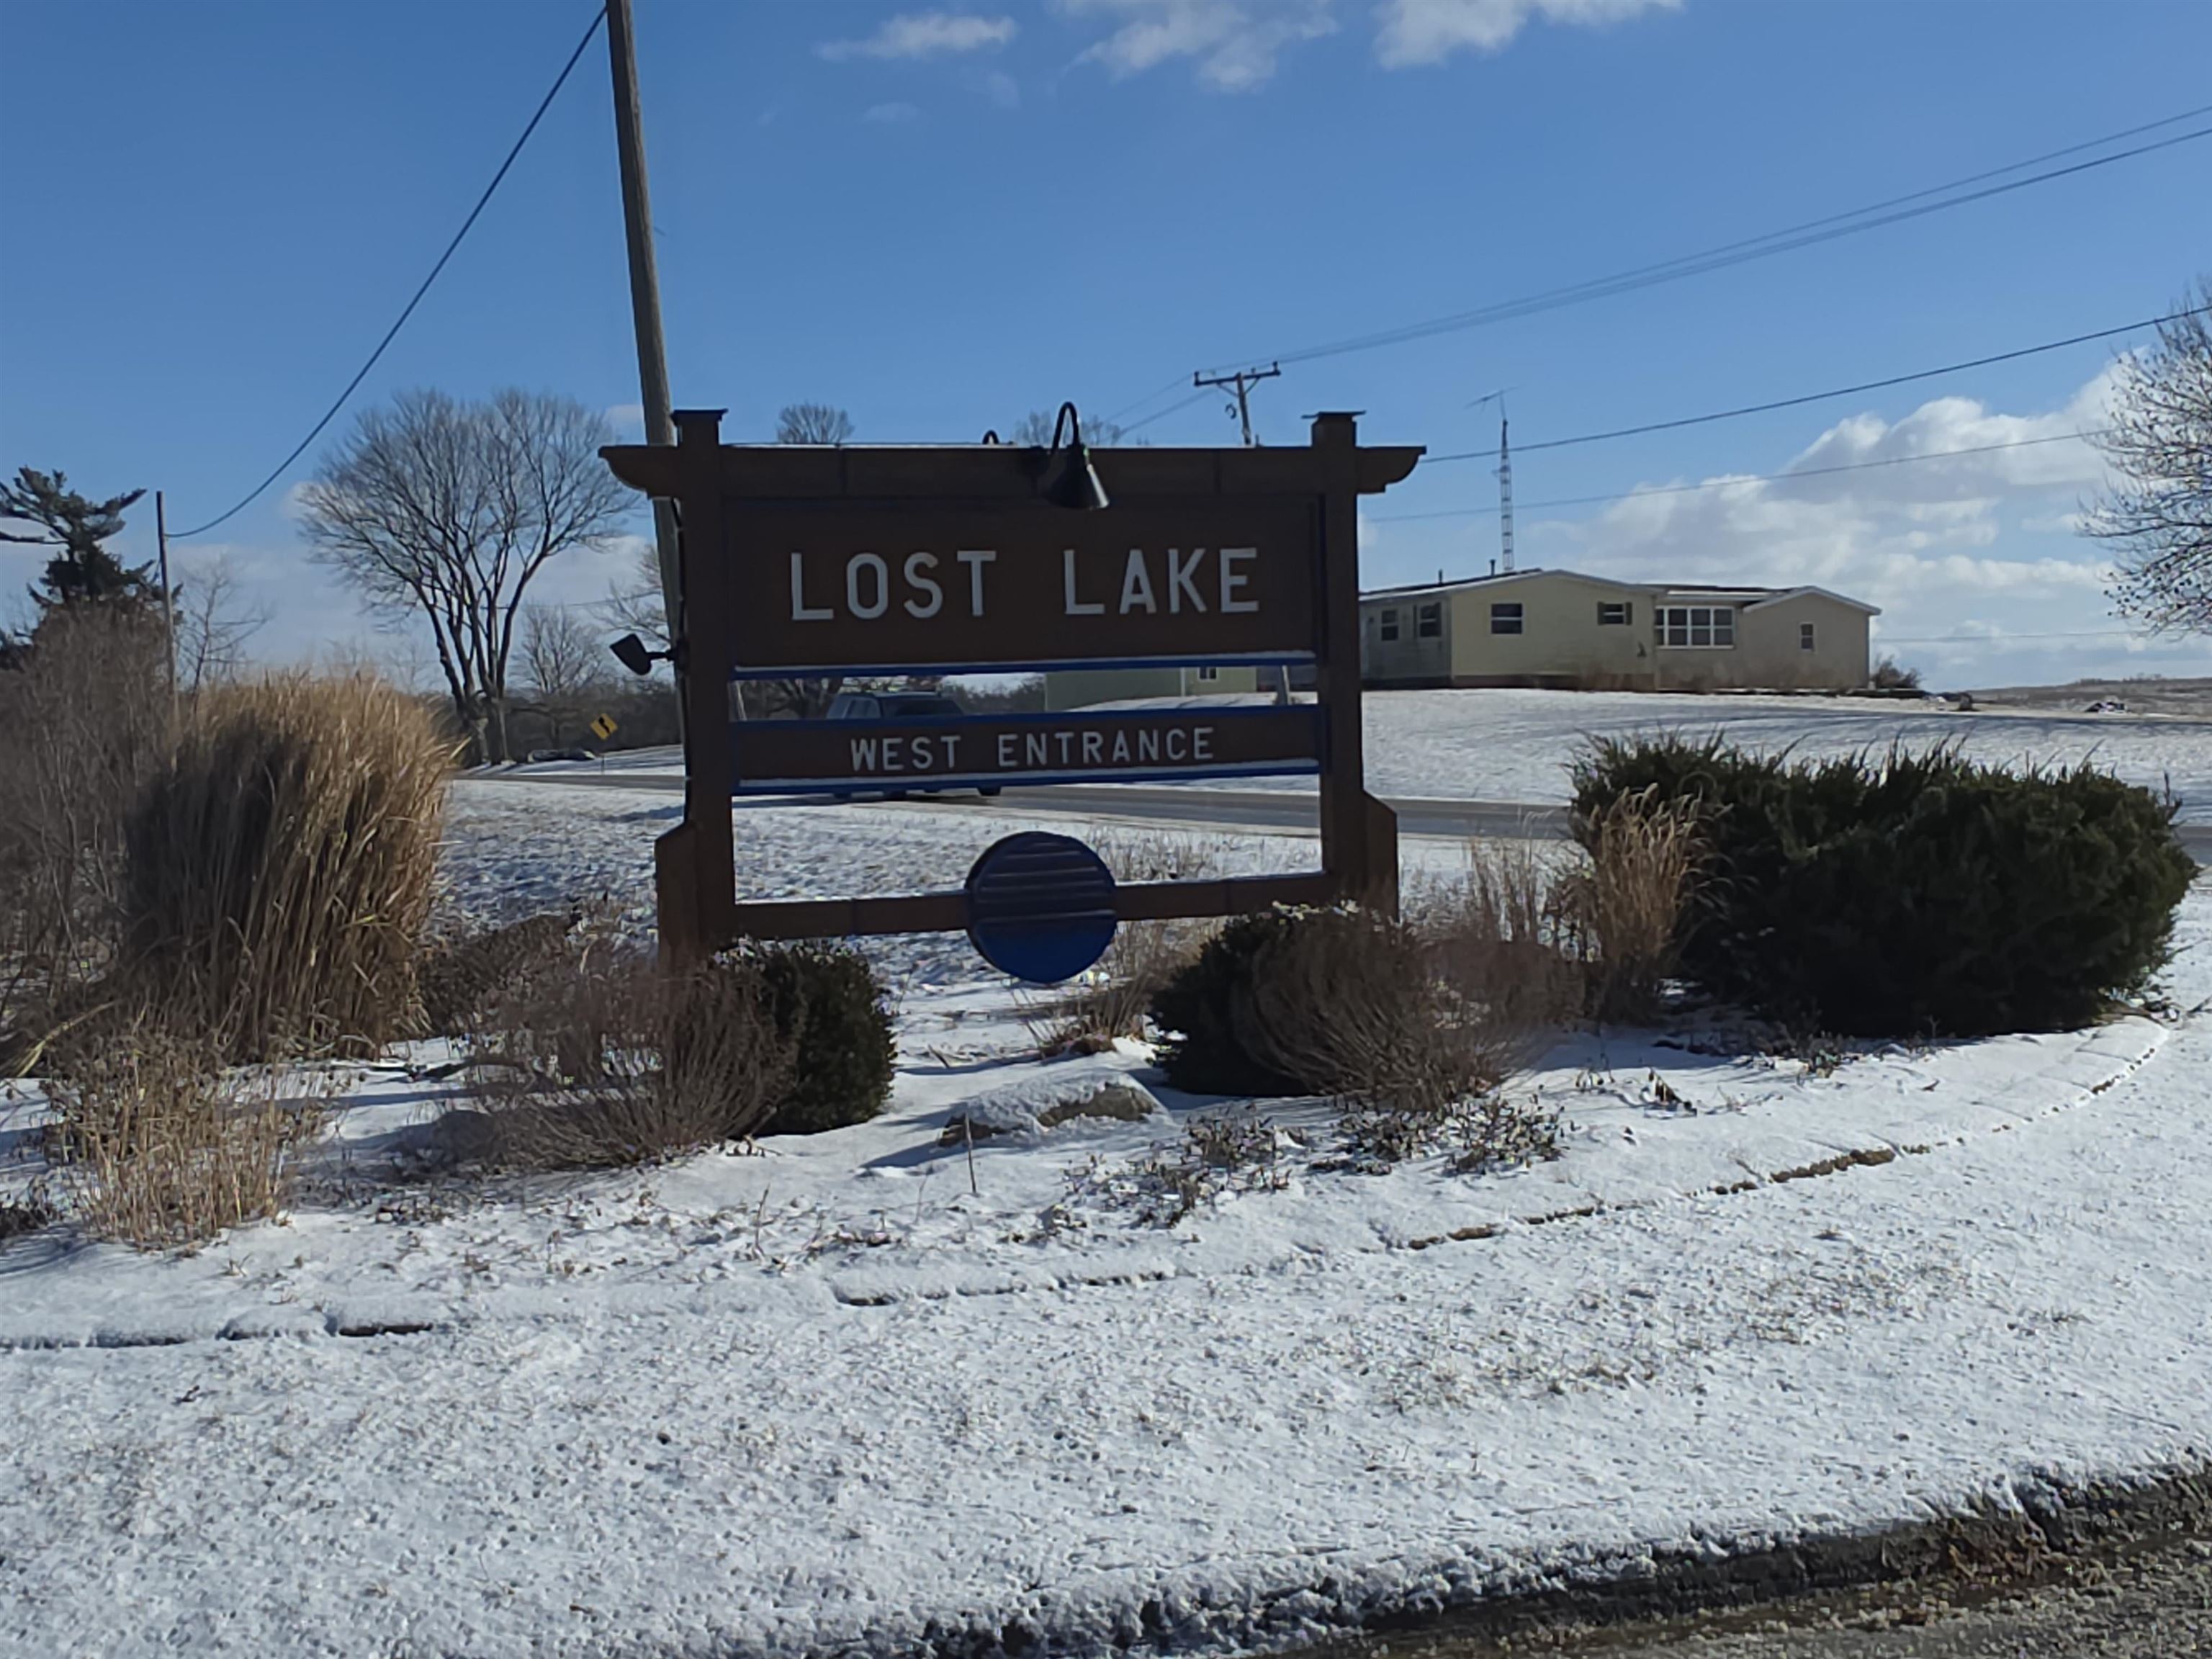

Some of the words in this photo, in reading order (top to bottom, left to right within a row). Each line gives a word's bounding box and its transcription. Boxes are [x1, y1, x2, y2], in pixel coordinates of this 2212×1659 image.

[791, 550, 997, 621] LOST
[1063, 547, 1259, 615] LAKE
[850, 735, 961, 770] WEST
[997, 727, 1214, 767] ENTRANCE
